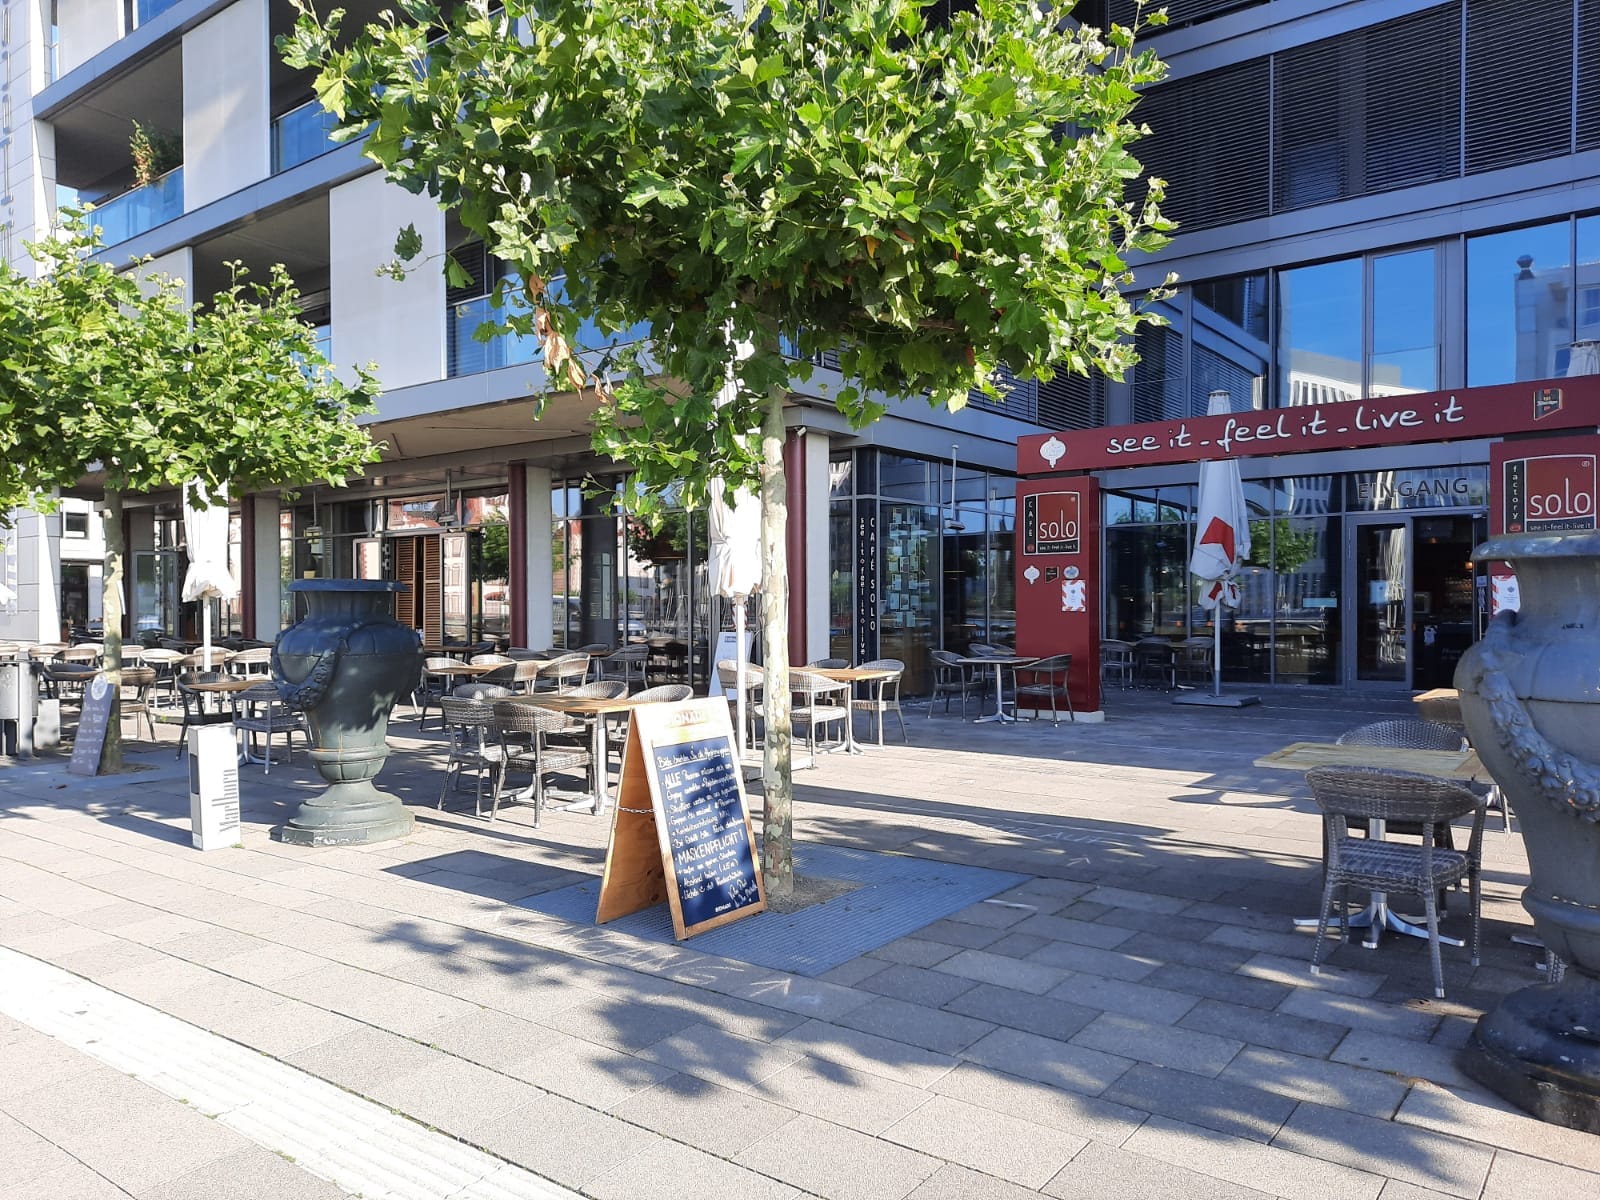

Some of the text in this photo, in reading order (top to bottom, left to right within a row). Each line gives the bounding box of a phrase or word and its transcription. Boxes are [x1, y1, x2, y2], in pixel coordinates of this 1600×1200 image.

[1107, 436, 1161, 454] see
[1169, 424, 1192, 448] it
[1216, 414, 1291, 452] feel
[1301, 409, 1327, 435] it
[1355, 406, 1424, 431] live
[1434, 395, 1465, 423] it
[1358, 477, 1469, 499] EINGANG
[1530, 477, 1591, 516] solo
[1040, 509, 1077, 539] solo
[664, 772, 682, 786] ALLE
[677, 832, 739, 865] MASKENPFLICHT
